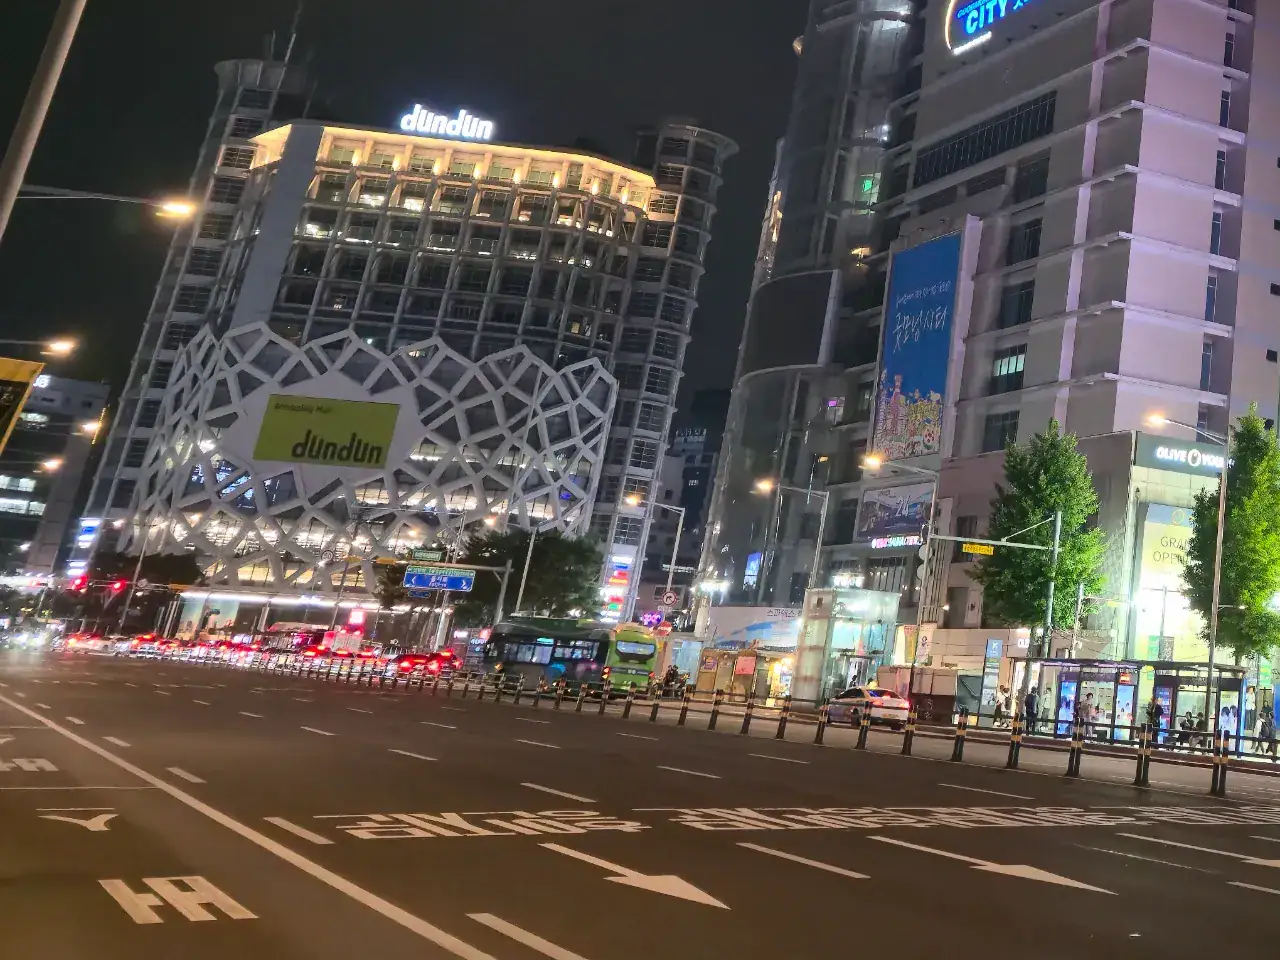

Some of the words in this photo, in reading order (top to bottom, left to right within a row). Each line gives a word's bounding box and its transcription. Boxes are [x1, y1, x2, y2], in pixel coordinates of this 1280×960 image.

[400, 103, 493, 140] dundun
[291, 429, 382, 464] dundun
[1156, 446, 1187, 462] OLIVE
[1202, 454, 1235, 469] YOUG
[1161, 537, 1191, 550] GRAN
